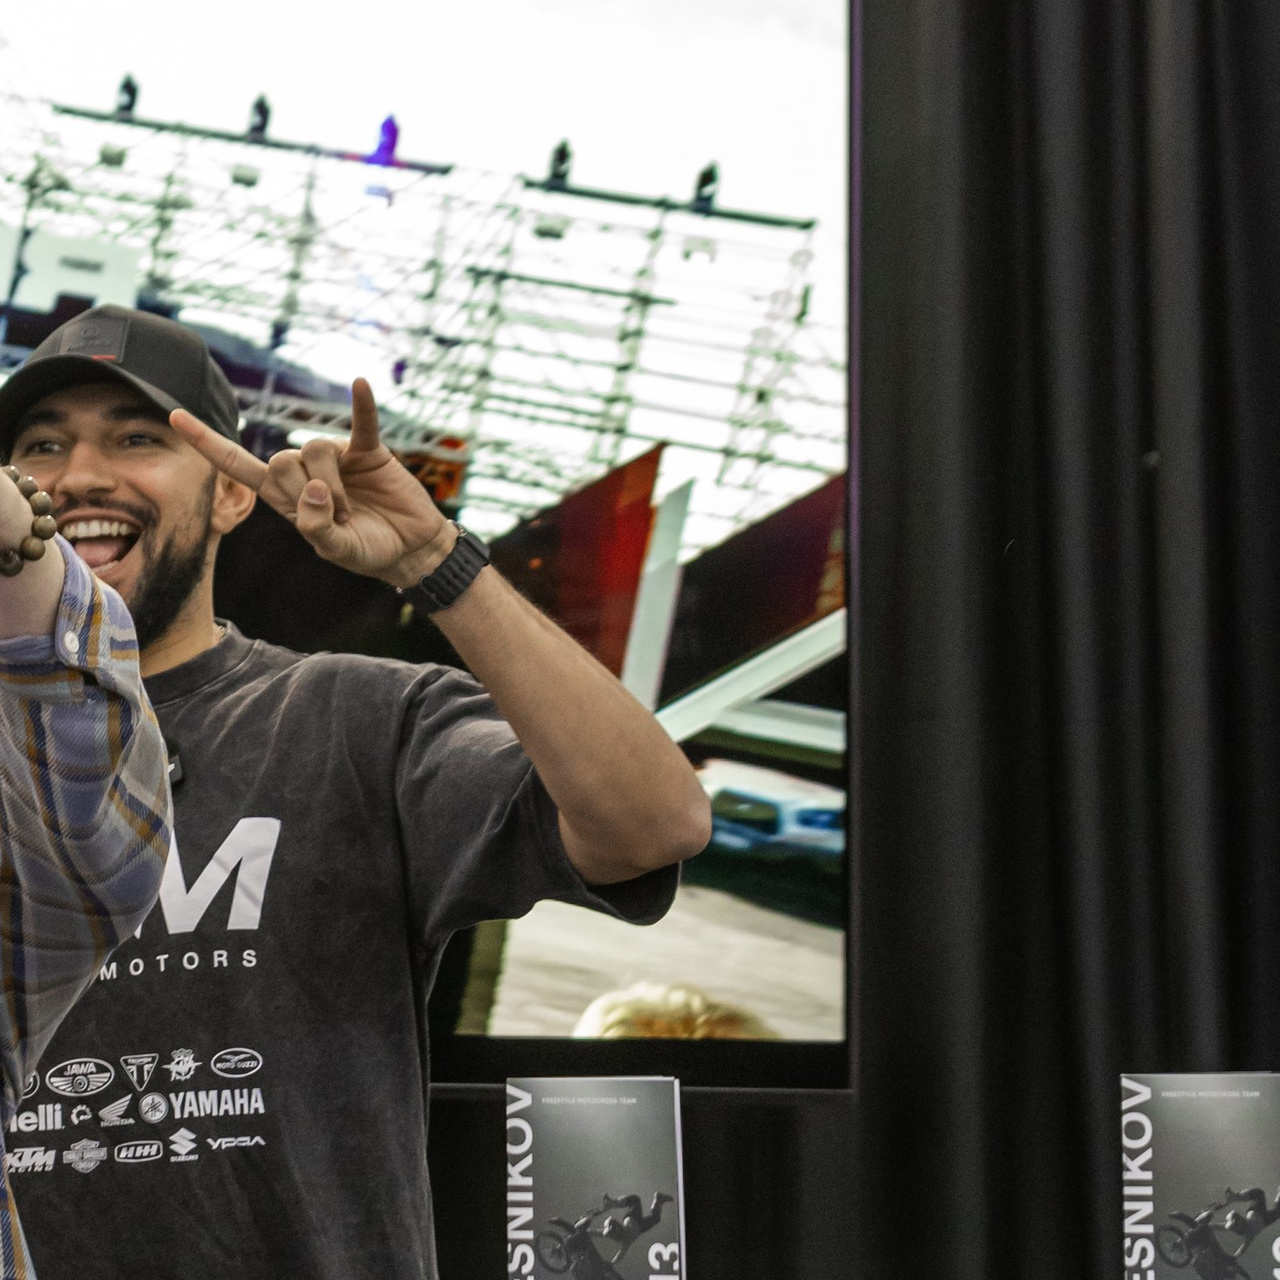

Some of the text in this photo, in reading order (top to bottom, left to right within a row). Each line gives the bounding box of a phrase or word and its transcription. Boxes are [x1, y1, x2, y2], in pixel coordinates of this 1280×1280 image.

[99, 949, 258, 982] MOTORS
[63, 1061, 98, 1076] JAWA
[168, 1087, 266, 1120] YAMAHA
[5, 1146, 57, 1168] KTM
